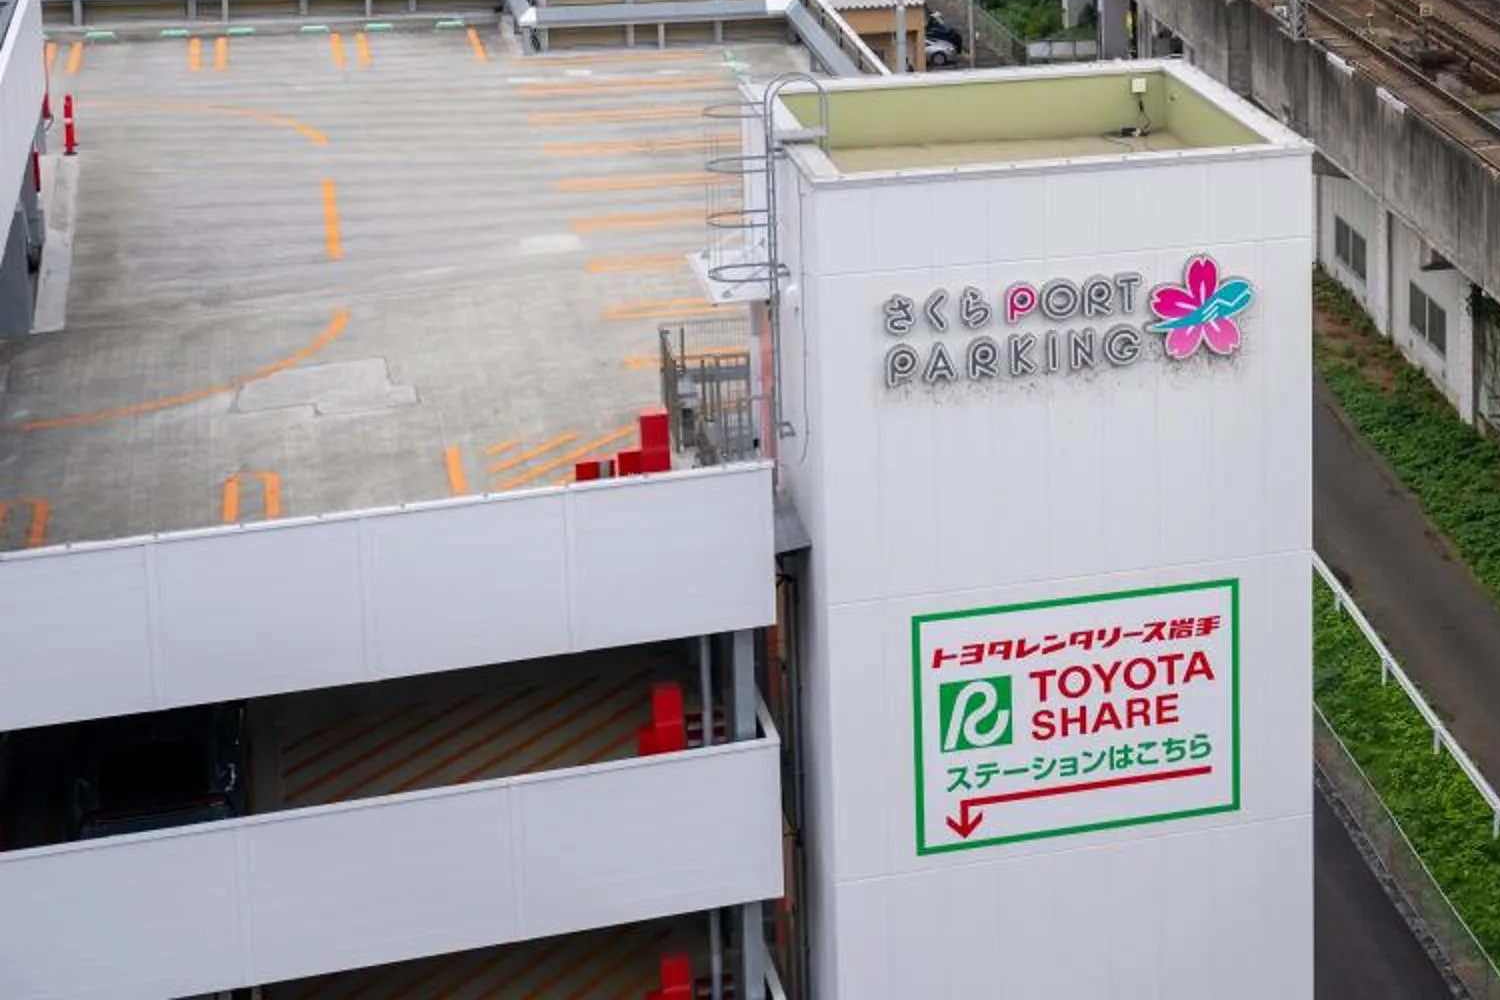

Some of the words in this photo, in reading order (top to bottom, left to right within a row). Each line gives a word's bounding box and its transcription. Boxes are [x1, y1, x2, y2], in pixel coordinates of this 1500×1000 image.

[885, 323, 1142, 387] PARKING
[931, 615, 1221, 669] トヨタレンタリース岩手
[1029, 651, 1215, 702] TOYOTA
[1031, 693, 1180, 741] SHARE
[946, 733, 1212, 792] ステーションはこちら
